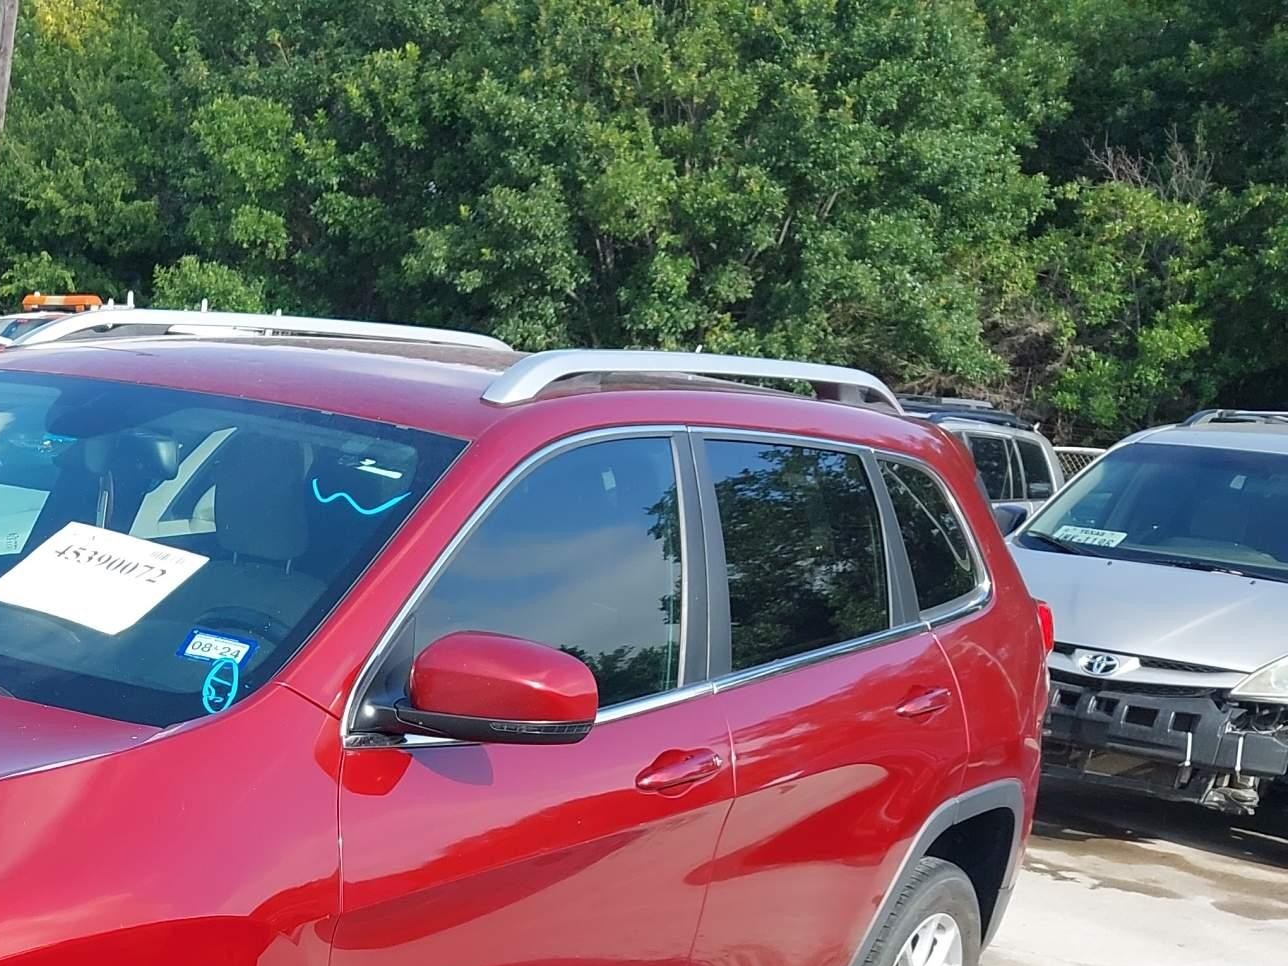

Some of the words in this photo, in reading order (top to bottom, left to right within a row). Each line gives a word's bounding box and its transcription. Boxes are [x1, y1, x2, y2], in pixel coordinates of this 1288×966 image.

[54, 544, 167, 583] 45390072
[191, 640, 213, 653] 08
[219, 646, 241, 659] 24
